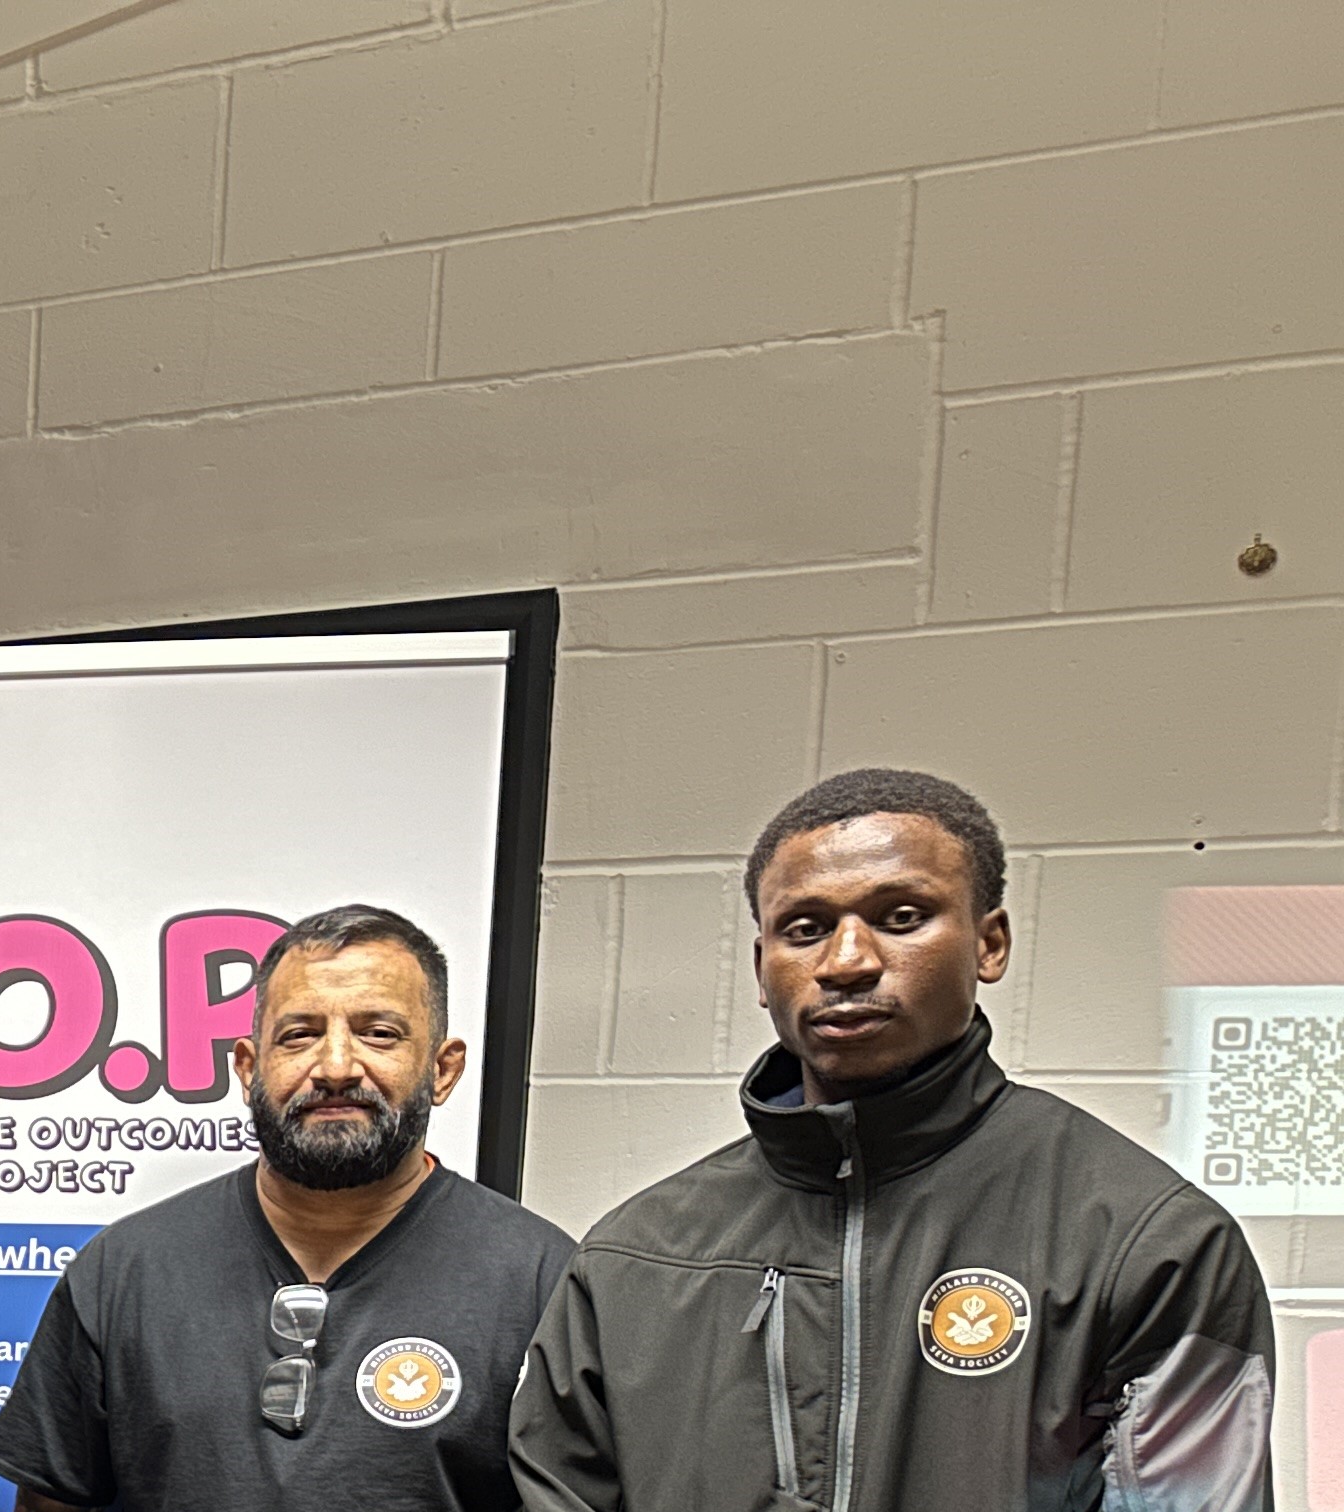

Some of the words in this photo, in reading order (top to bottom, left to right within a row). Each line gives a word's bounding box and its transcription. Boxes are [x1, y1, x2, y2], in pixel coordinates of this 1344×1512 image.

[931, 1276, 979, 1302] MIDLAND
[984, 1277, 1023, 1308] LANGAR
[929, 1345, 954, 1365] SEVA
[959, 1348, 1008, 1368] SOCIETY
[399, 1403, 440, 1420] SOCIETY
